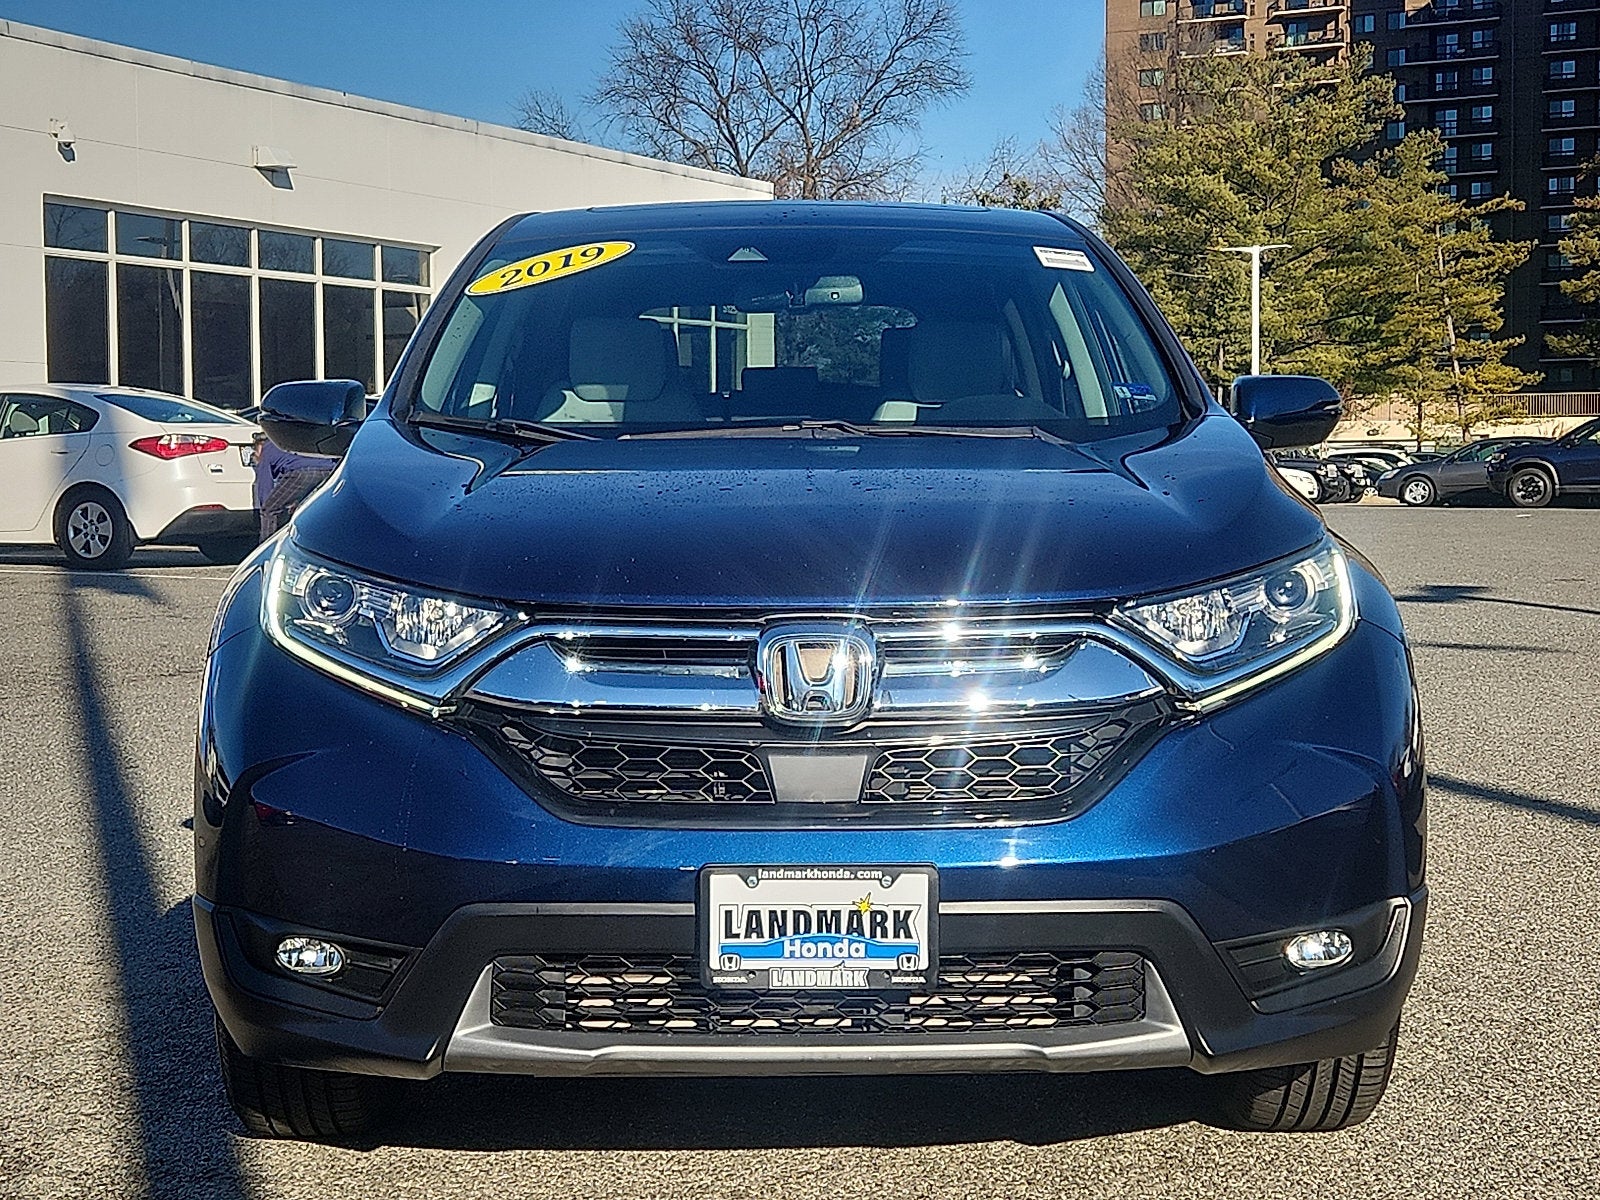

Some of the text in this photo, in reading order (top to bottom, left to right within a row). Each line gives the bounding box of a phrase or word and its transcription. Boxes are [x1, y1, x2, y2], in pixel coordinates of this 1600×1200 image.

[500, 246, 605, 288] 2019
[724, 909, 914, 939] LANDMARK
[783, 939, 867, 959] Honda
[771, 969, 867, 988] LANDMARK
